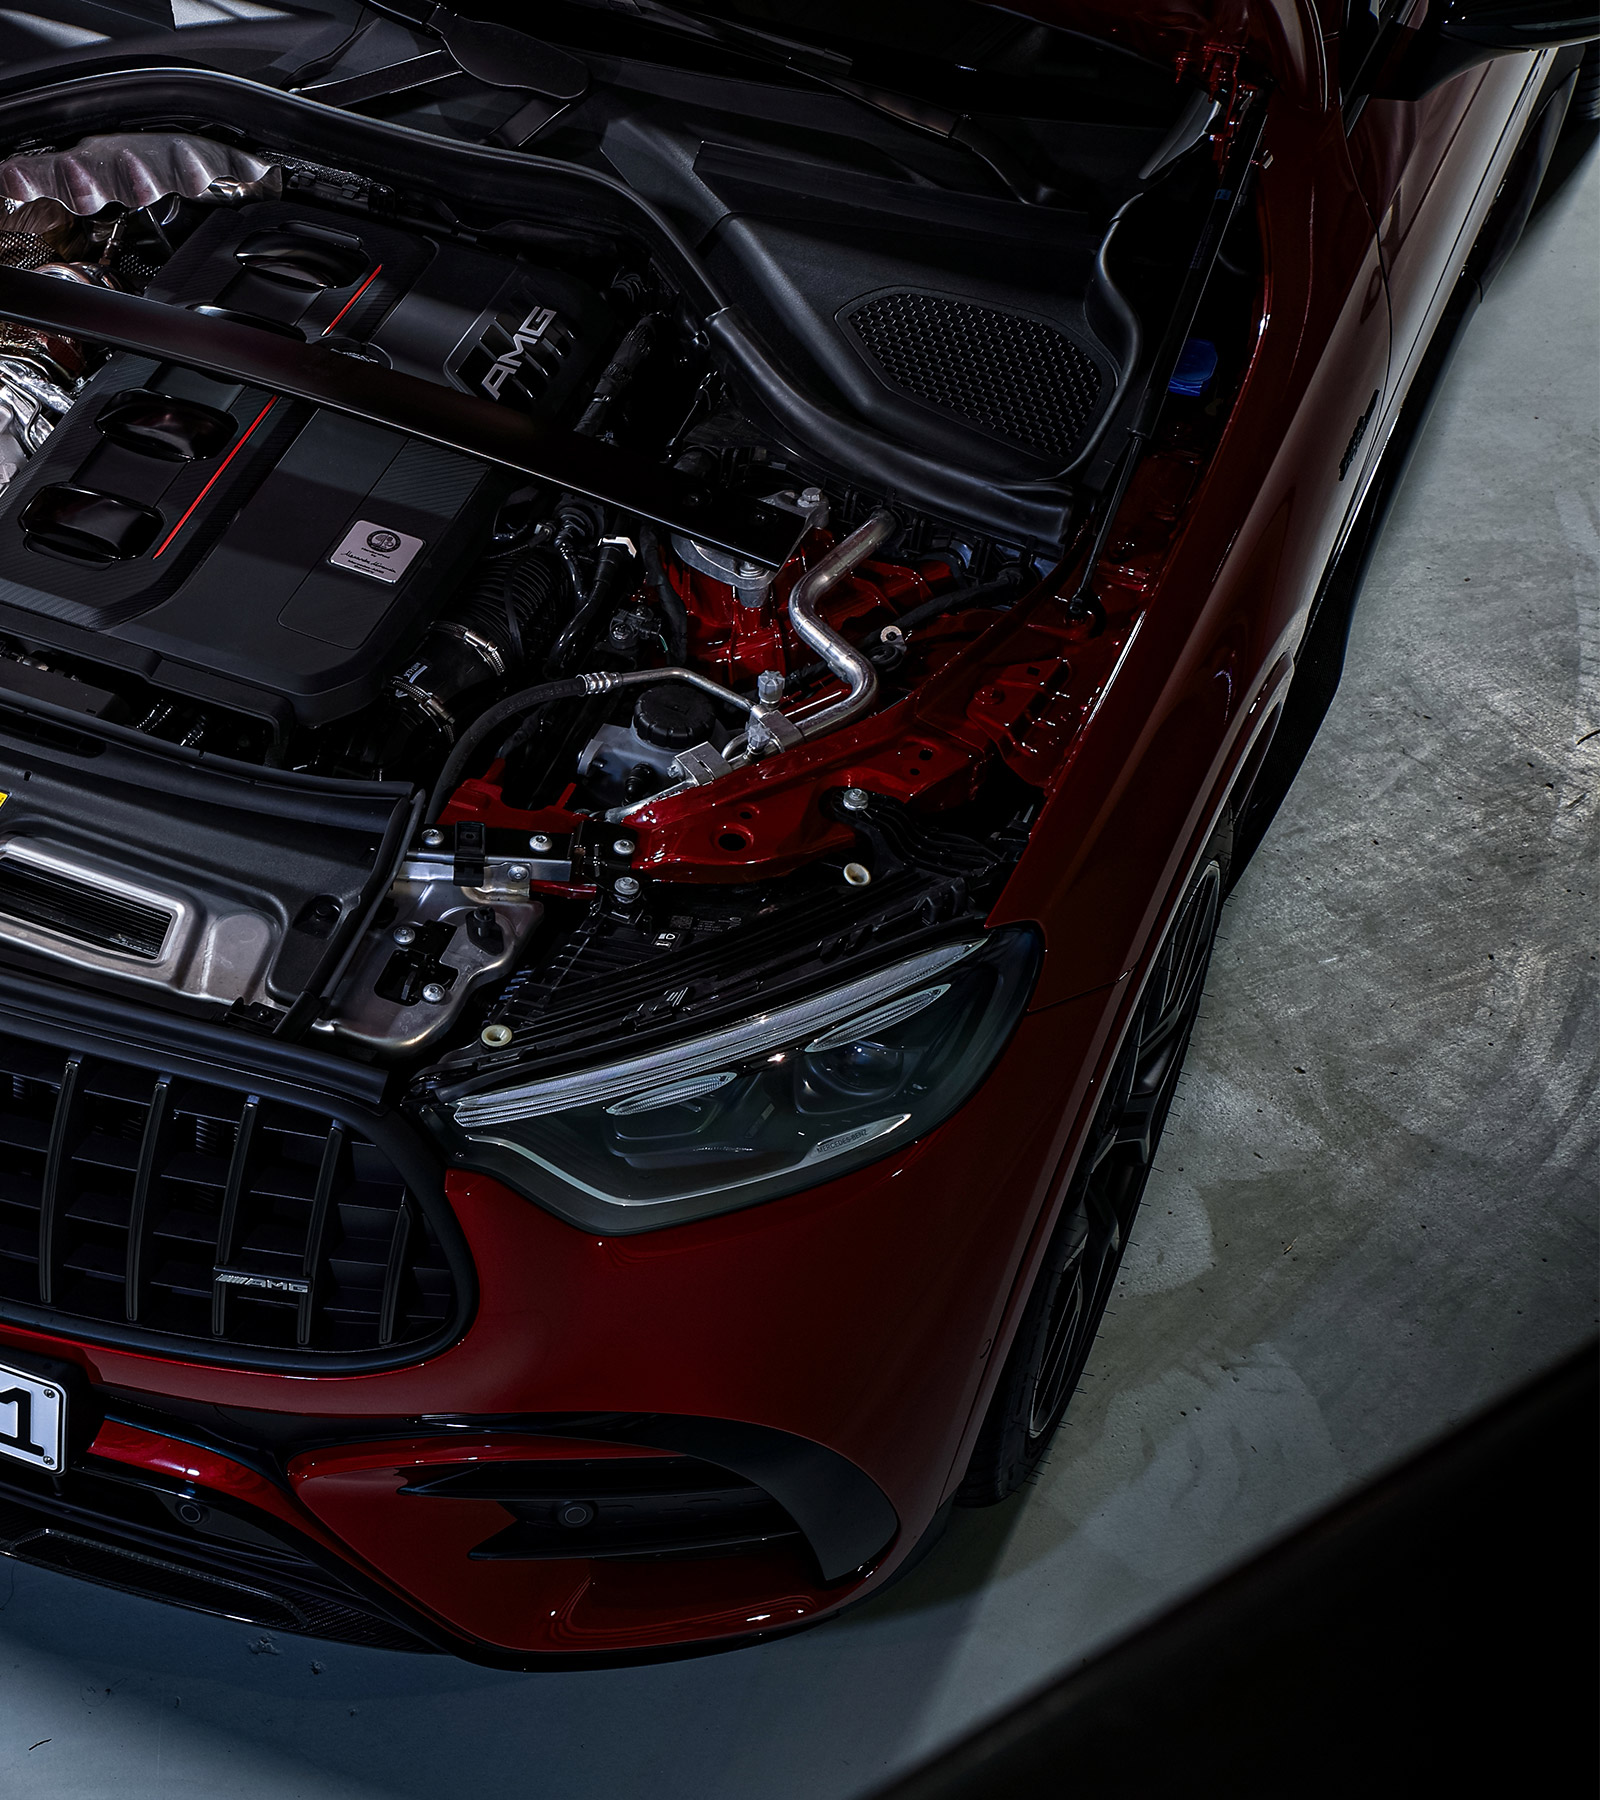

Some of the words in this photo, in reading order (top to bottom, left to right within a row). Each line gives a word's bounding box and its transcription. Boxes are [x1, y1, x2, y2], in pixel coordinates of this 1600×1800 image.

[481, 305, 557, 400] AMG
[816, 1128, 868, 1153] MERCEDES-BENZ
[246, 1277, 308, 1293] AMG
